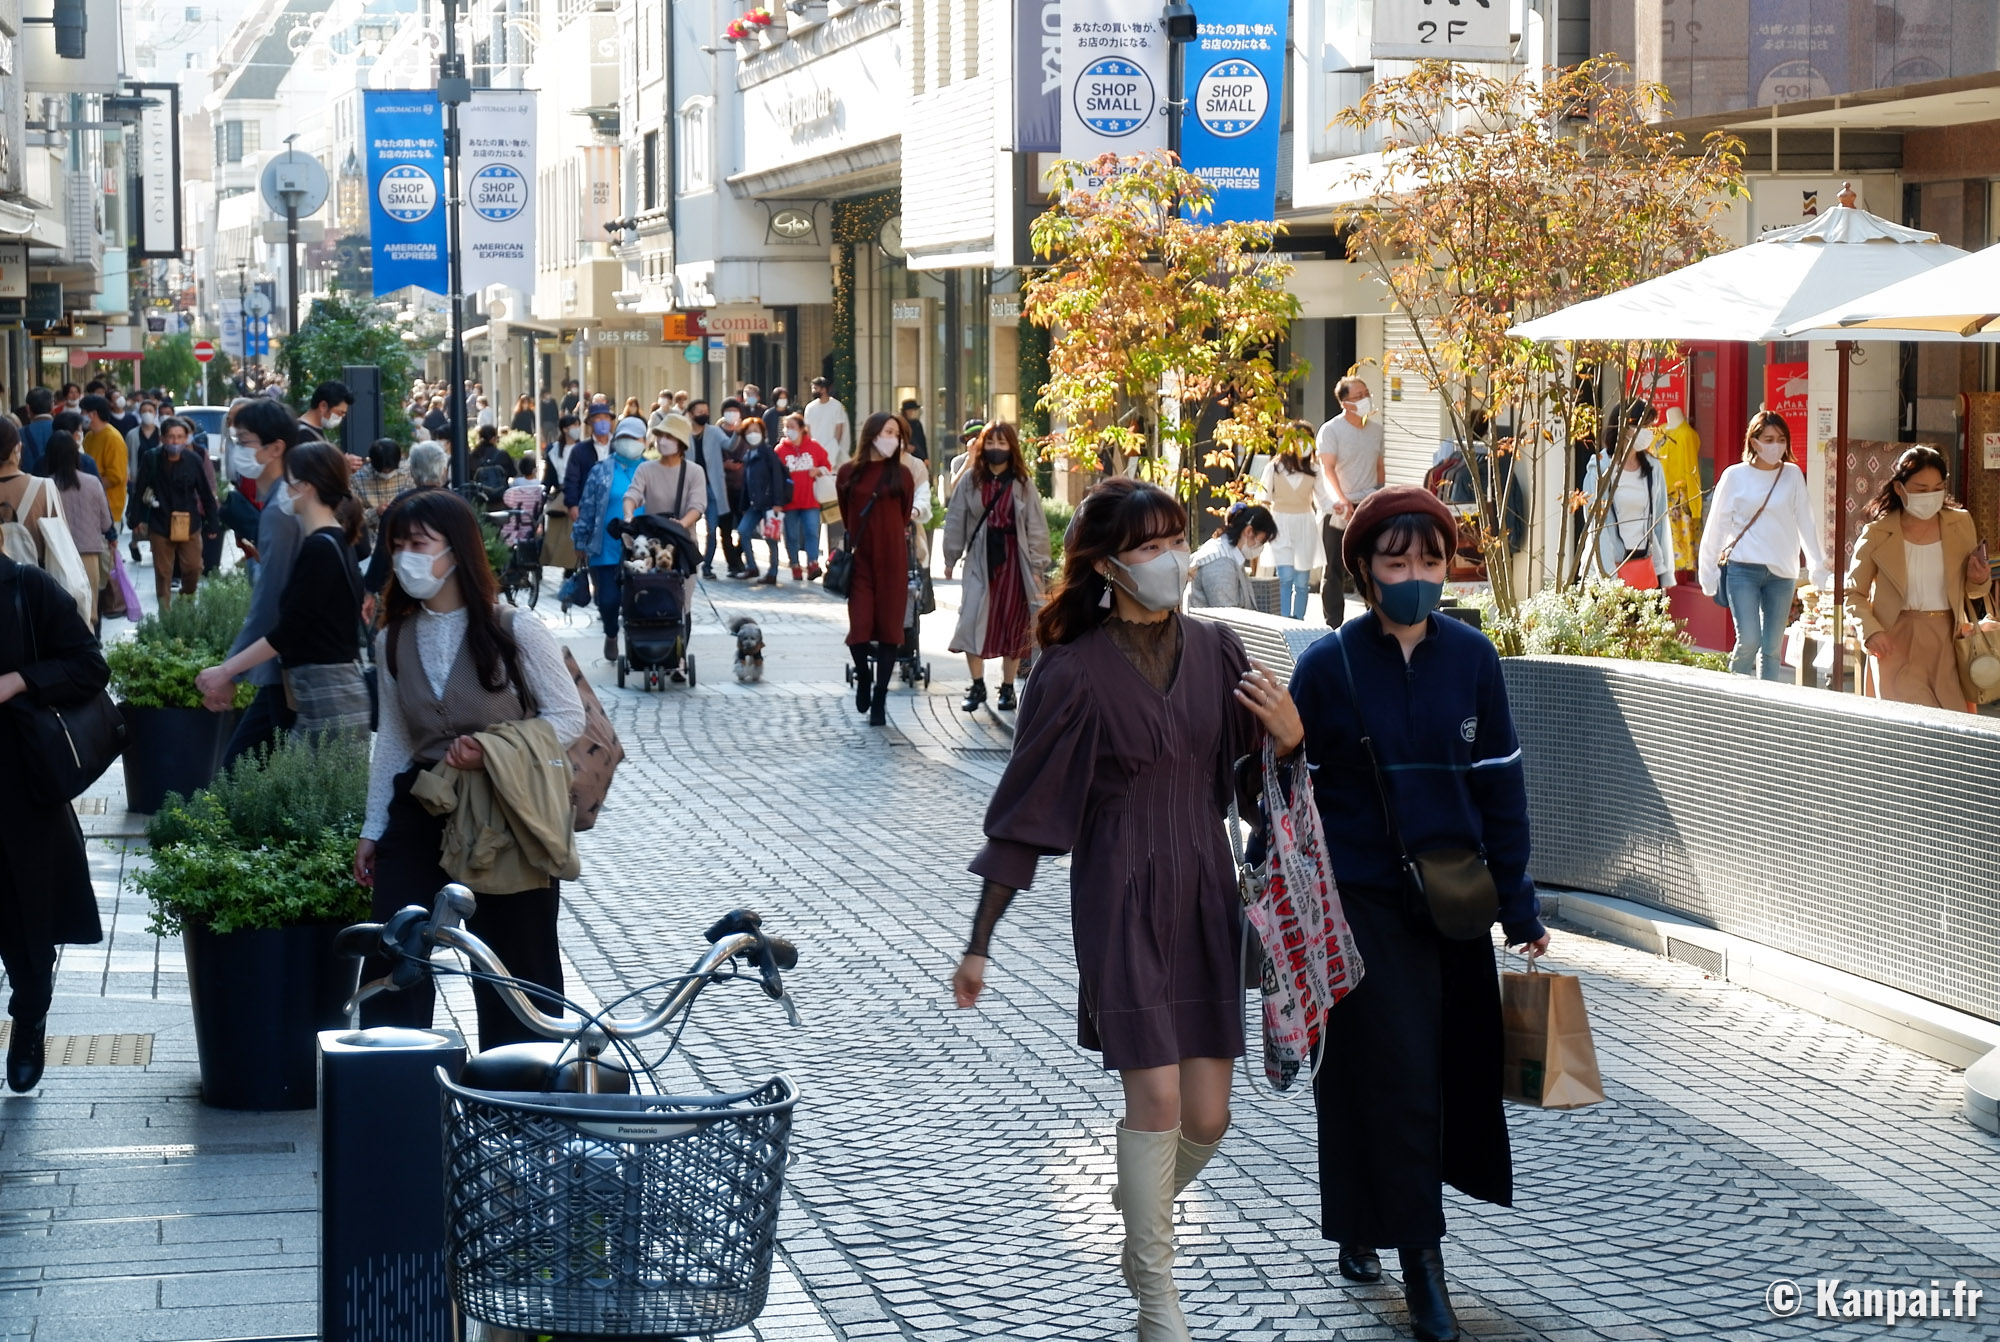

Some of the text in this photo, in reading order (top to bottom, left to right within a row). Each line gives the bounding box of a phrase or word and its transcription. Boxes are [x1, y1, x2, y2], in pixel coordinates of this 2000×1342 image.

[1072, 22, 1157, 33] あなたの買い物が、
[1196, 24, 1277, 36] あなたの買い物が、
[1418, 21, 1468, 43] 2F
[1041, 1, 1061, 95] URA
[1078, 37, 1152, 48] お店の力になる。
[1201, 38, 1271, 50] お店の力になる。
[1091, 83, 1136, 96] SHOP
[1212, 85, 1252, 97] SHOP
[1086, 97, 1142, 111] SMALL
[1206, 99, 1256, 112] SMALL
[1193, 167, 1259, 178] AMERICAN
[391, 183, 424, 194] SHOP
[482, 182, 515, 193] SHOP
[388, 194, 429, 204] SMALL
[478, 193, 518, 203] SMALL
[383, 243, 437, 252] AMERICAN
[472, 243, 524, 251] AMERICAN
[391, 251, 438, 260] EXPRESS
[479, 251, 524, 259] EXPRESS
[711, 313, 769, 330] comia
[599, 331, 620, 341] DES
[1296, 895, 1309, 916] ECO
[618, 1126, 657, 1134] Panasonic
